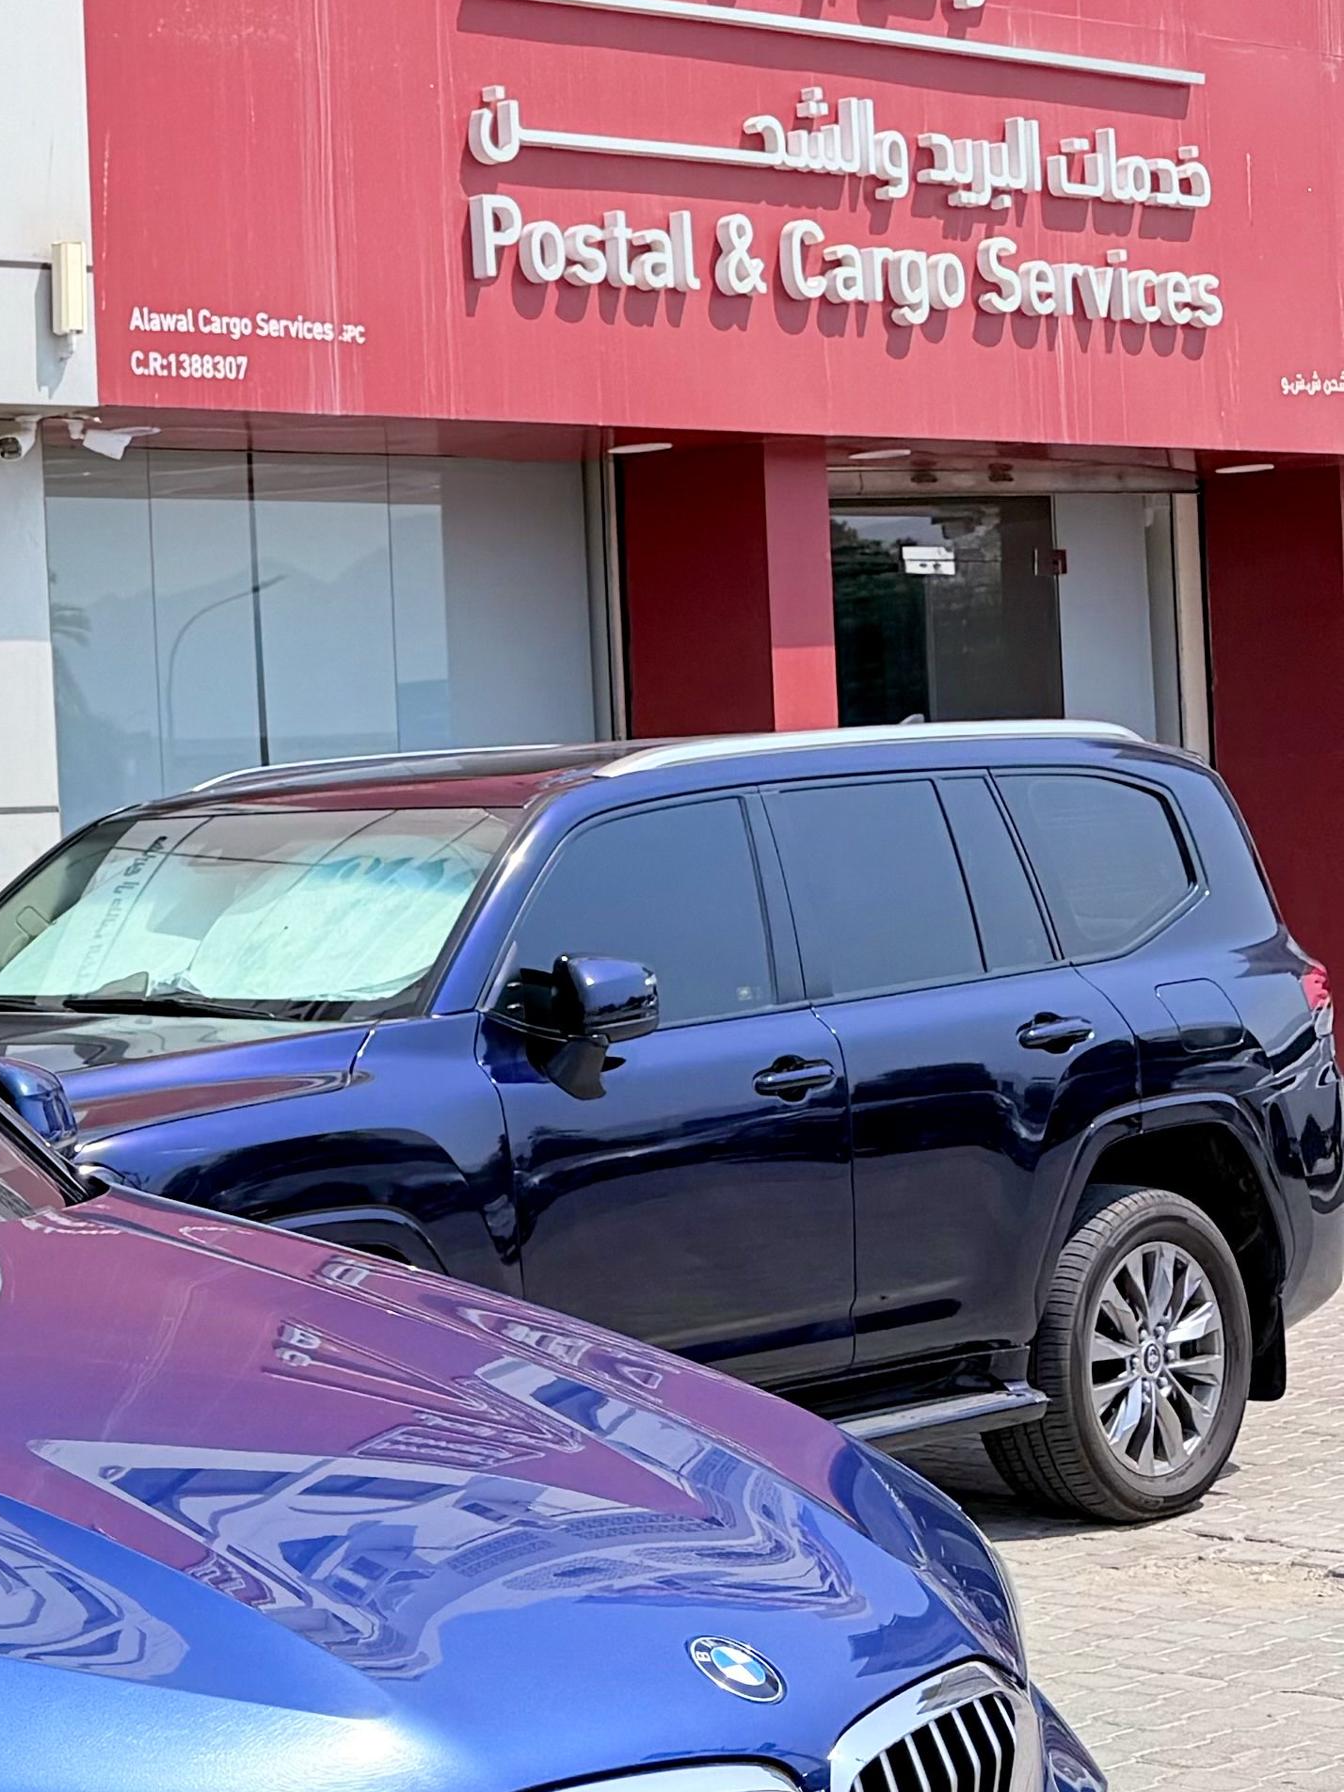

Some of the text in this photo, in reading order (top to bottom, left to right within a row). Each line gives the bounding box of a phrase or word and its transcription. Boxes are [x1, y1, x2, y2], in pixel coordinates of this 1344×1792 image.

[917, 117, 1042, 210] البريد
[1046, 127, 1212, 208] خدمات
[469, 195, 1223, 329] Postal & Cargo Services
[129, 307, 194, 333] Alawal
[198, 309, 252, 340] Cargo
[256, 312, 333, 342] Services
[130, 351, 248, 381] C.R:1388307
